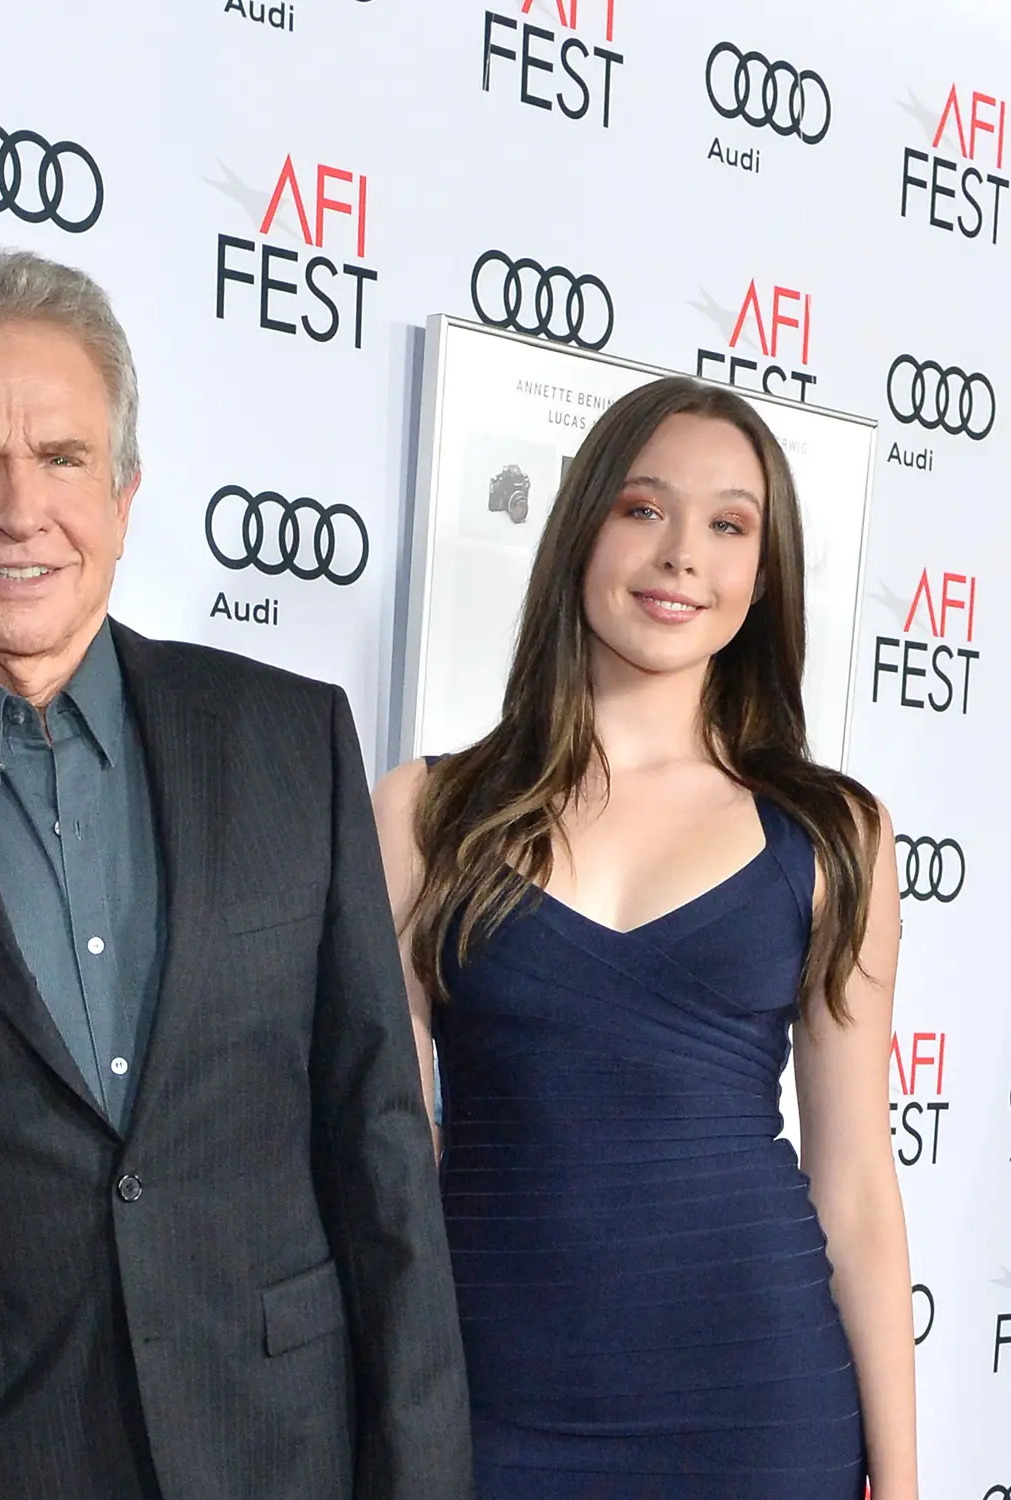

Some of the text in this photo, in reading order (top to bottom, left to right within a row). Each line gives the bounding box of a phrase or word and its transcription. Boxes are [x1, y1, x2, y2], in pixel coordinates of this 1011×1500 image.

[224, 0, 294, 32] Audi
[482, 10, 624, 128] FEST
[707, 137, 761, 173] Audi
[932, 82, 1005, 169] AFI
[260, 153, 367, 258] AFI
[901, 147, 1010, 245] FEST
[216, 233, 378, 349] FEST
[728, 277, 811, 365] AFI
[516, 379, 573, 403] ANNETTE
[548, 409, 586, 430] LUCAS
[887, 442, 933, 472] Audi
[210, 592, 278, 626] Audi
[903, 567, 976, 642] AFI
[872, 636, 980, 714] FEST
